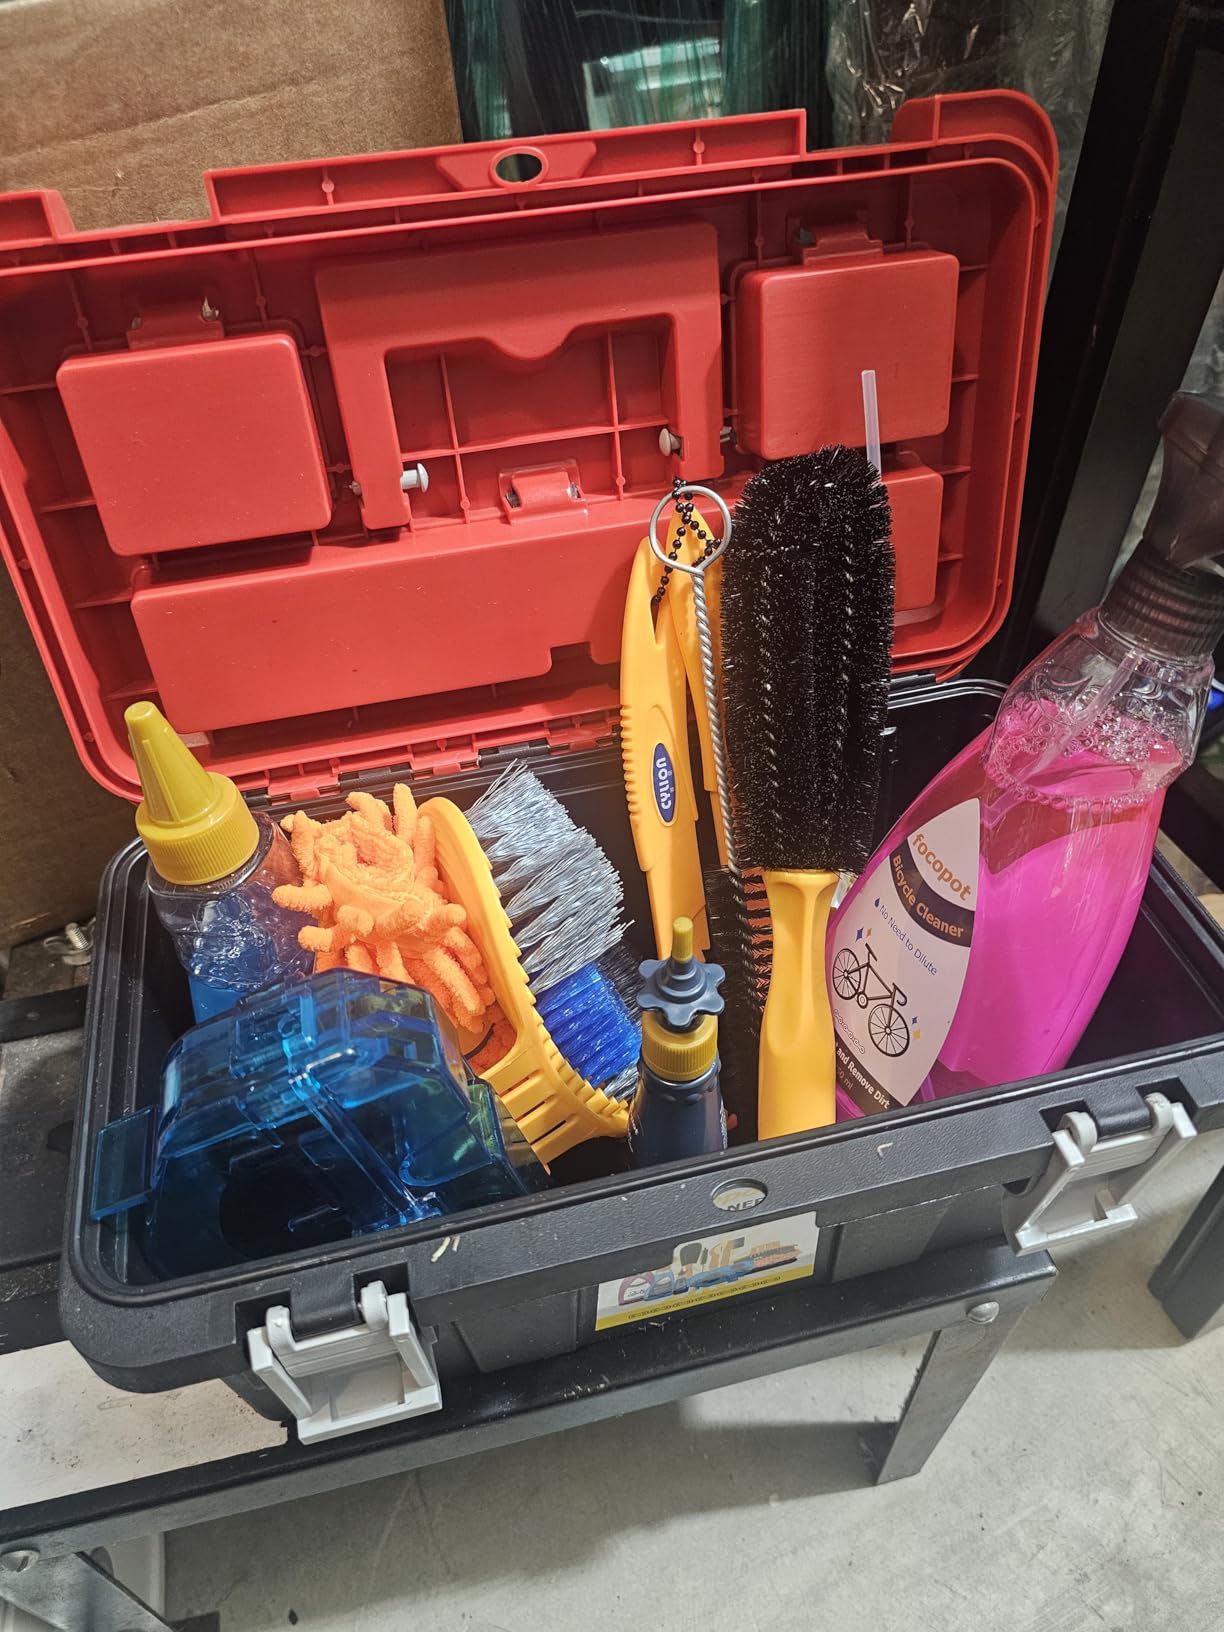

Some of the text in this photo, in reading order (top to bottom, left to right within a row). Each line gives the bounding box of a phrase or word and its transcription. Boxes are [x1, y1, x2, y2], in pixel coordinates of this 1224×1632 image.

[893, 855, 964, 938] Bicycle Cleaner
[912, 833, 971, 901] focopot
[879, 905, 937, 976] No Need to Dilute
[837, 1048, 890, 1109] and Remove Dirt
